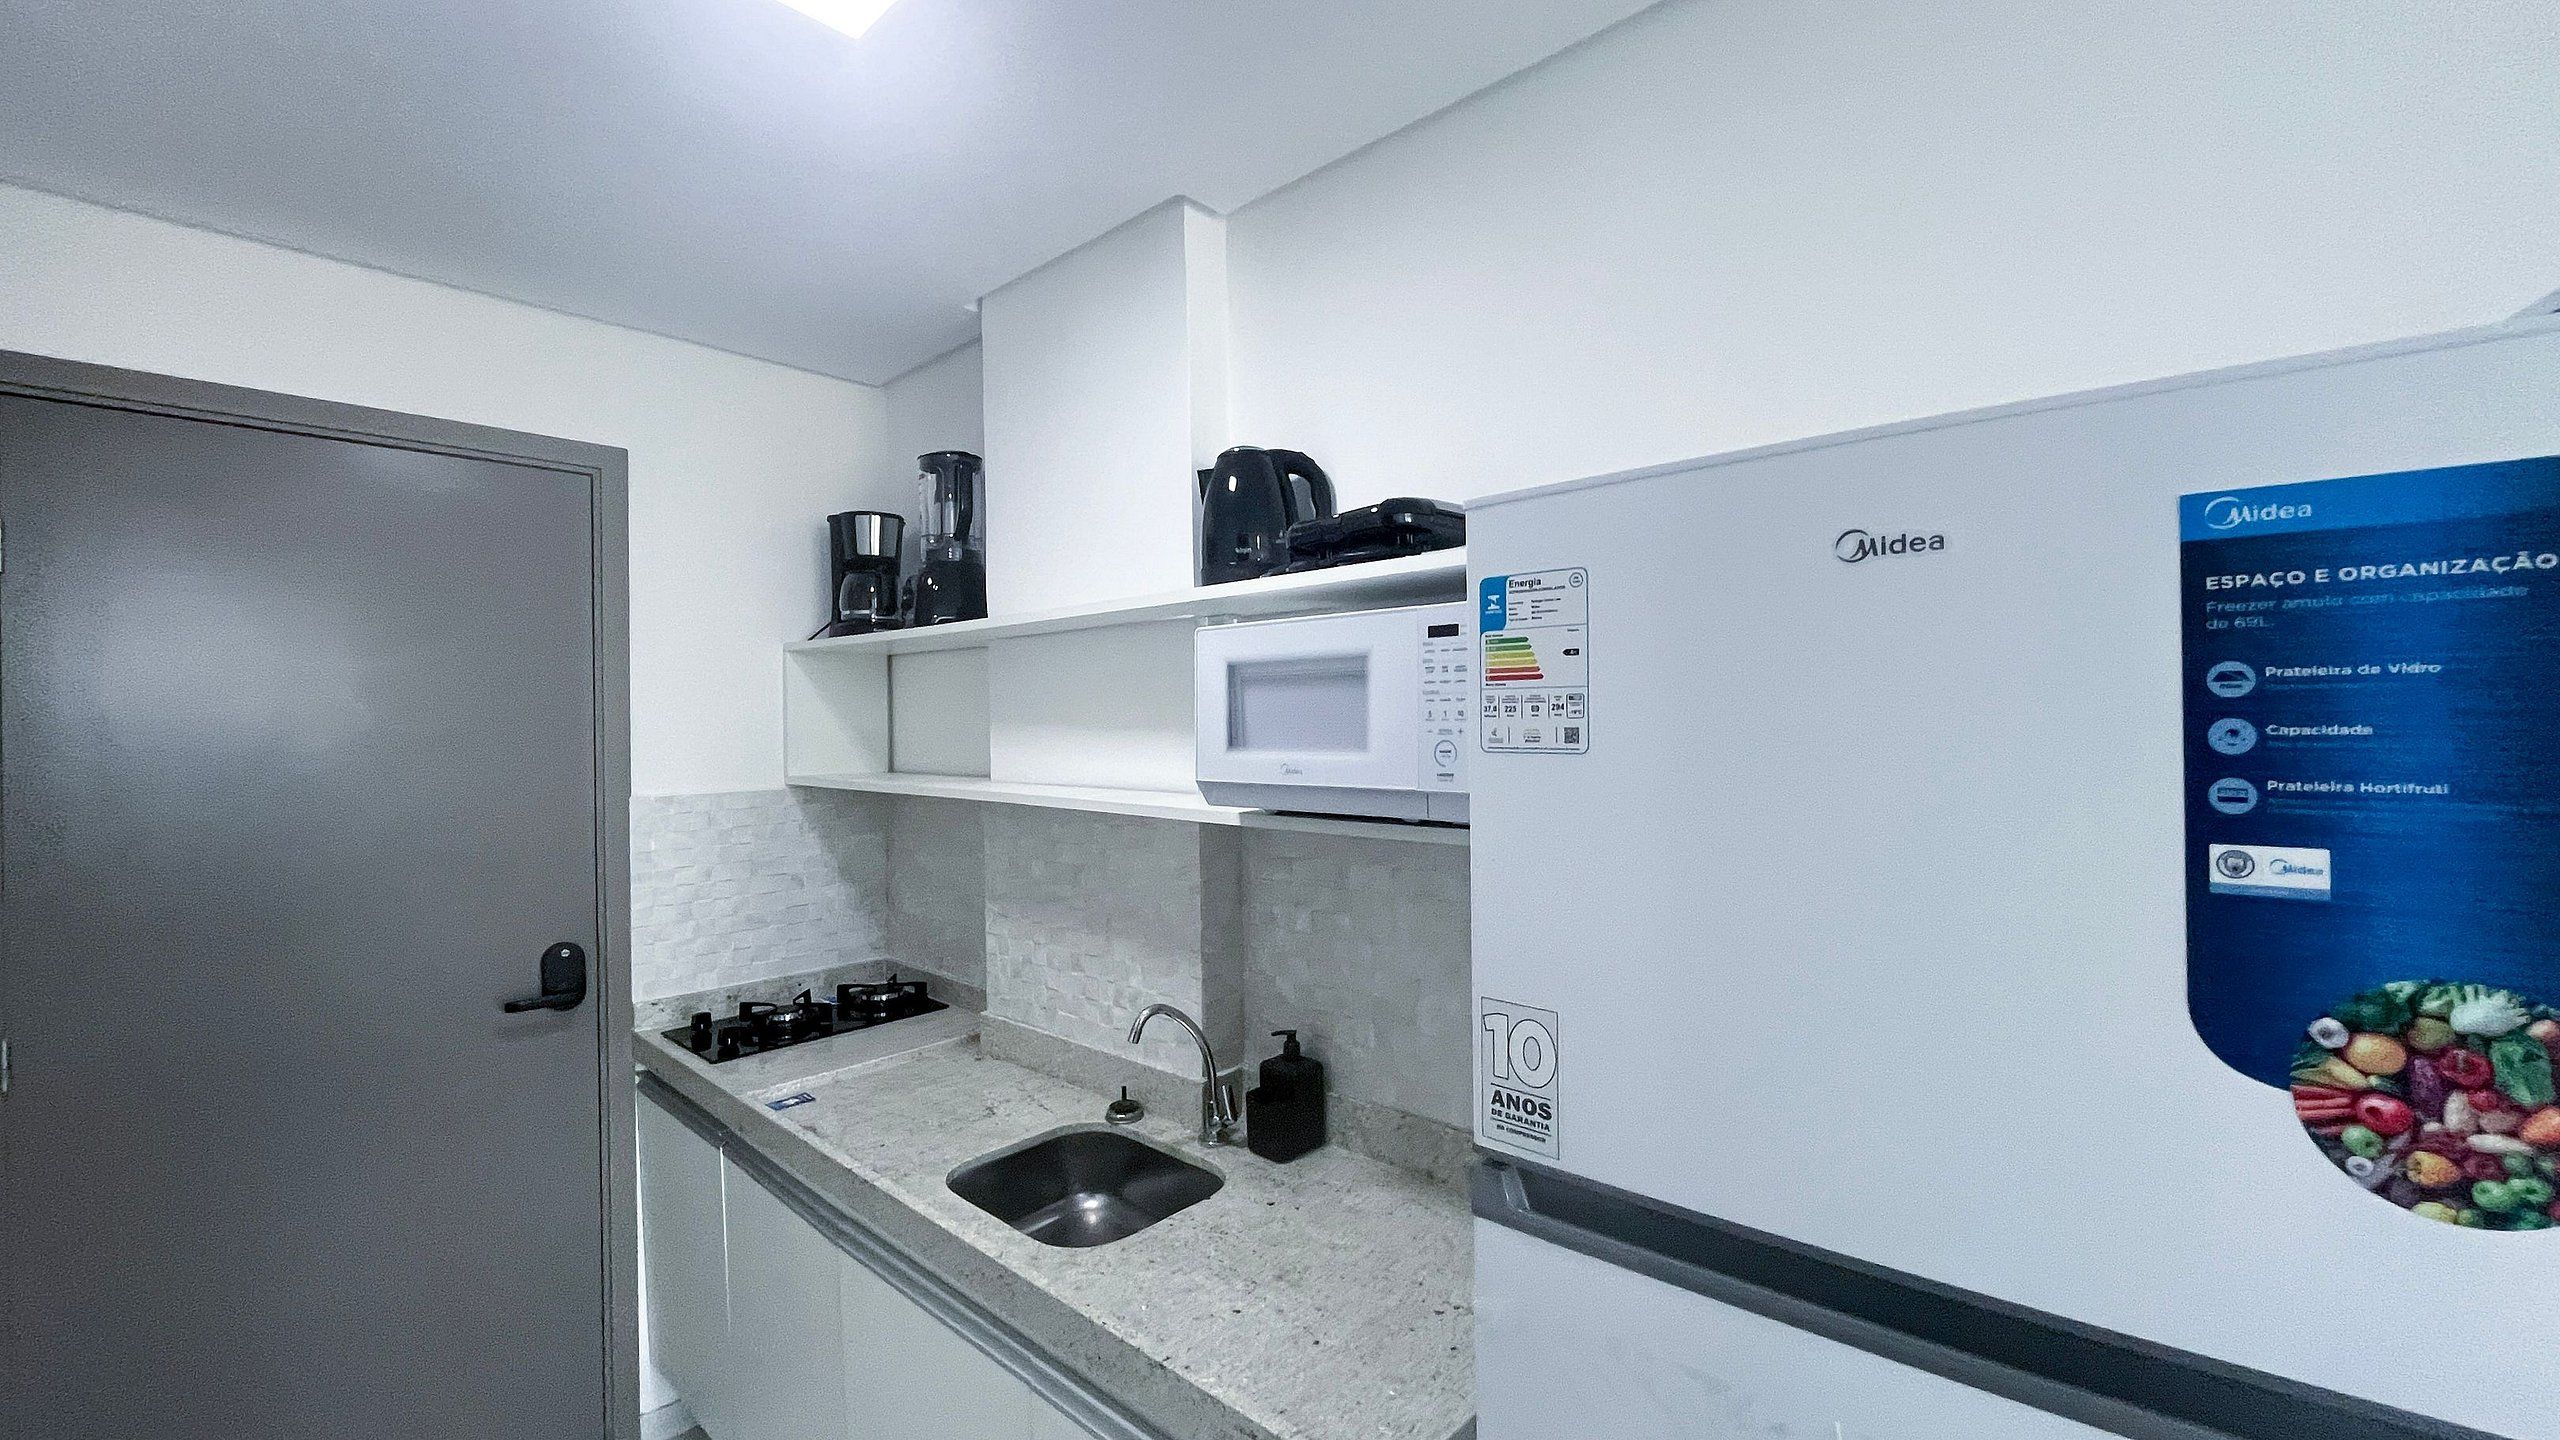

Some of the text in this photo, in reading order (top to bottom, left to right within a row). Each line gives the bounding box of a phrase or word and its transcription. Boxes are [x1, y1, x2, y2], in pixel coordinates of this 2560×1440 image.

[2204, 496, 2313, 530] Midea
[1835, 529, 1945, 563] Midea
[1508, 578, 1542, 589] Energia
[2205, 550, 2559, 591] ESPAÇO E ORGANIZAÇÃO
[2265, 665, 2352, 678] Prateleira
[2265, 724, 2374, 737] Capacidade
[2267, 780, 2450, 795] Prateleira Hortifruti
[1483, 1012, 1557, 1089] 10
[1491, 1089, 1552, 1121] ANOS
[1491, 1108, 1551, 1133] DE GARANTIA
